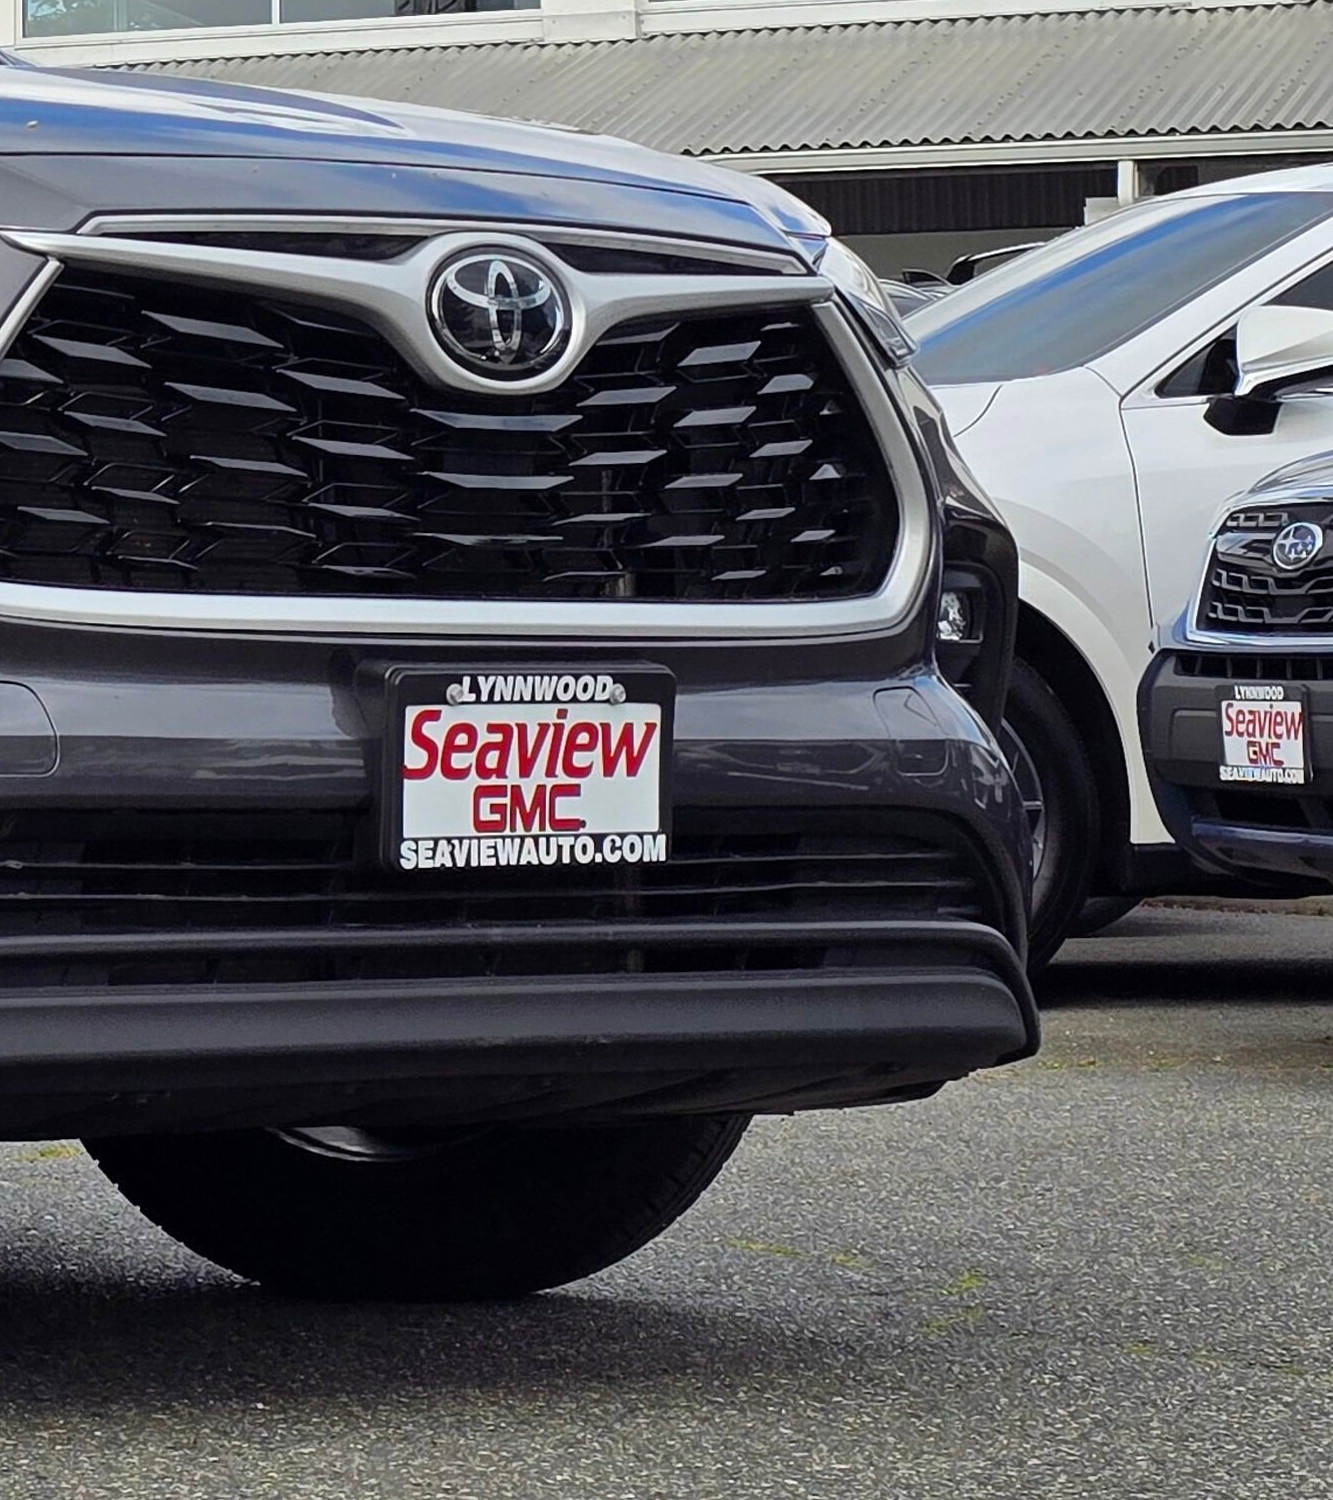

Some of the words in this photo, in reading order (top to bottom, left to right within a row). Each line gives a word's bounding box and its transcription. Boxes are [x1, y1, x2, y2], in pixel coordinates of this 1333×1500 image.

[461, 674, 614, 702] LYNNWOOD
[1225, 703, 1305, 740] Seaview
[402, 708, 658, 781] Seaview
[1246, 740, 1284, 766] GMC
[472, 784, 584, 832] GMC
[399, 835, 667, 870] SEAVIEWAUTO.COM
